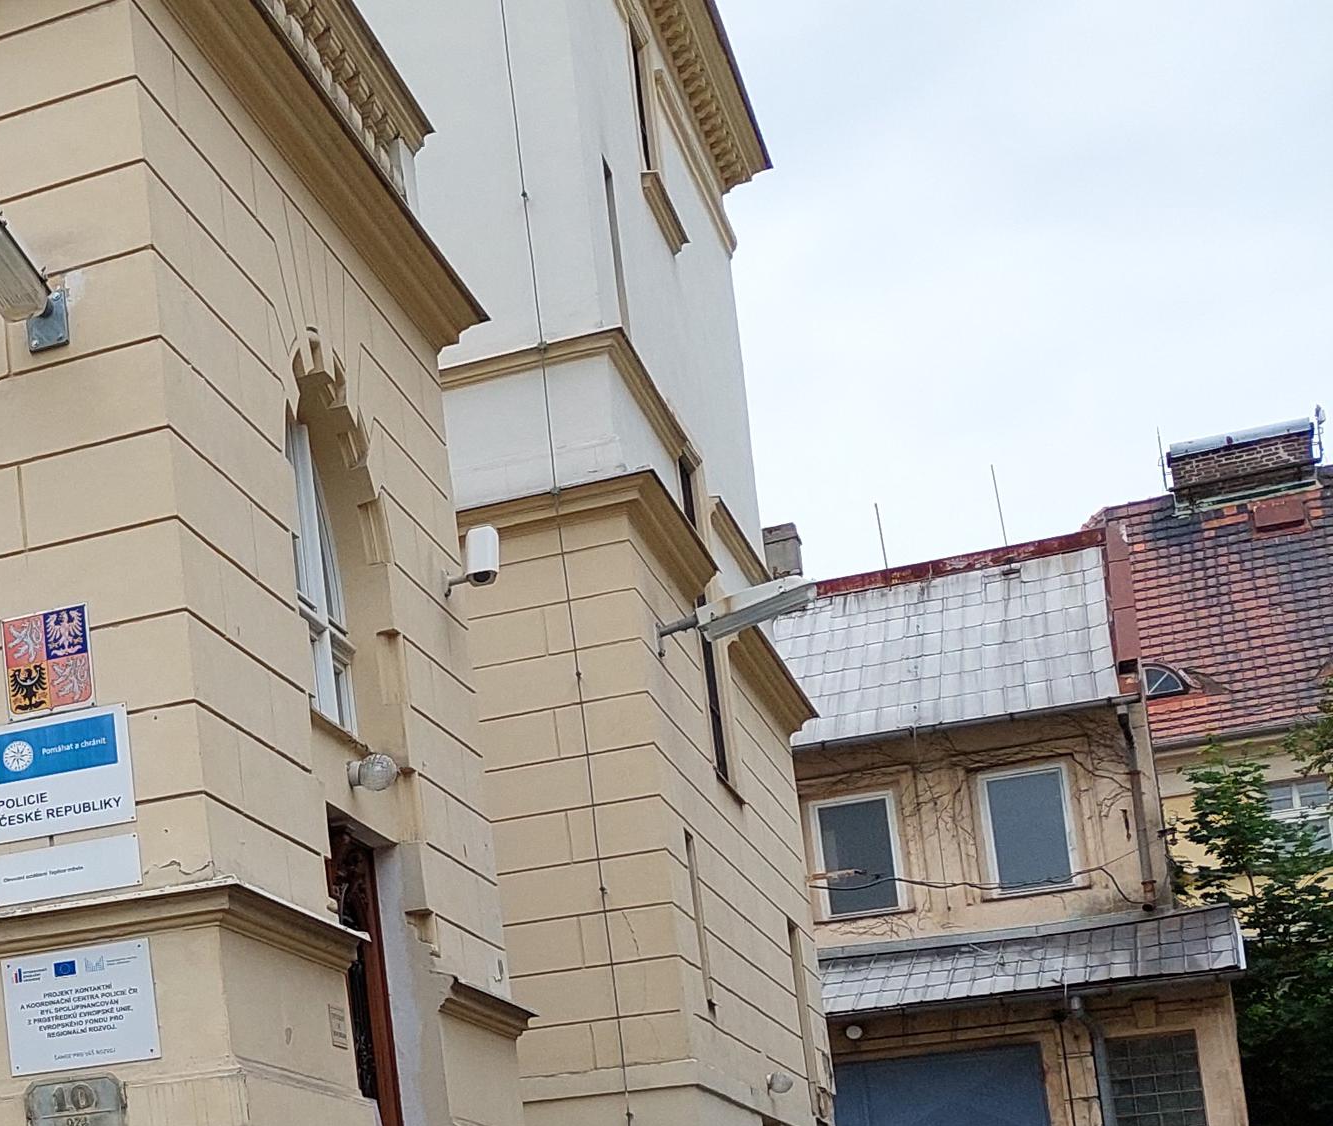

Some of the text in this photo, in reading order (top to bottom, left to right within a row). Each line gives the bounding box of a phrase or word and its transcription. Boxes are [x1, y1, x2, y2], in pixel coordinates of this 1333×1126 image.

[42, 743, 73, 755] Pomáhat
[81, 738, 106, 747] chránit
[0, 797, 121, 827] ČESKÉ REPUBLIKY
[53, 1084, 97, 1112] 10
